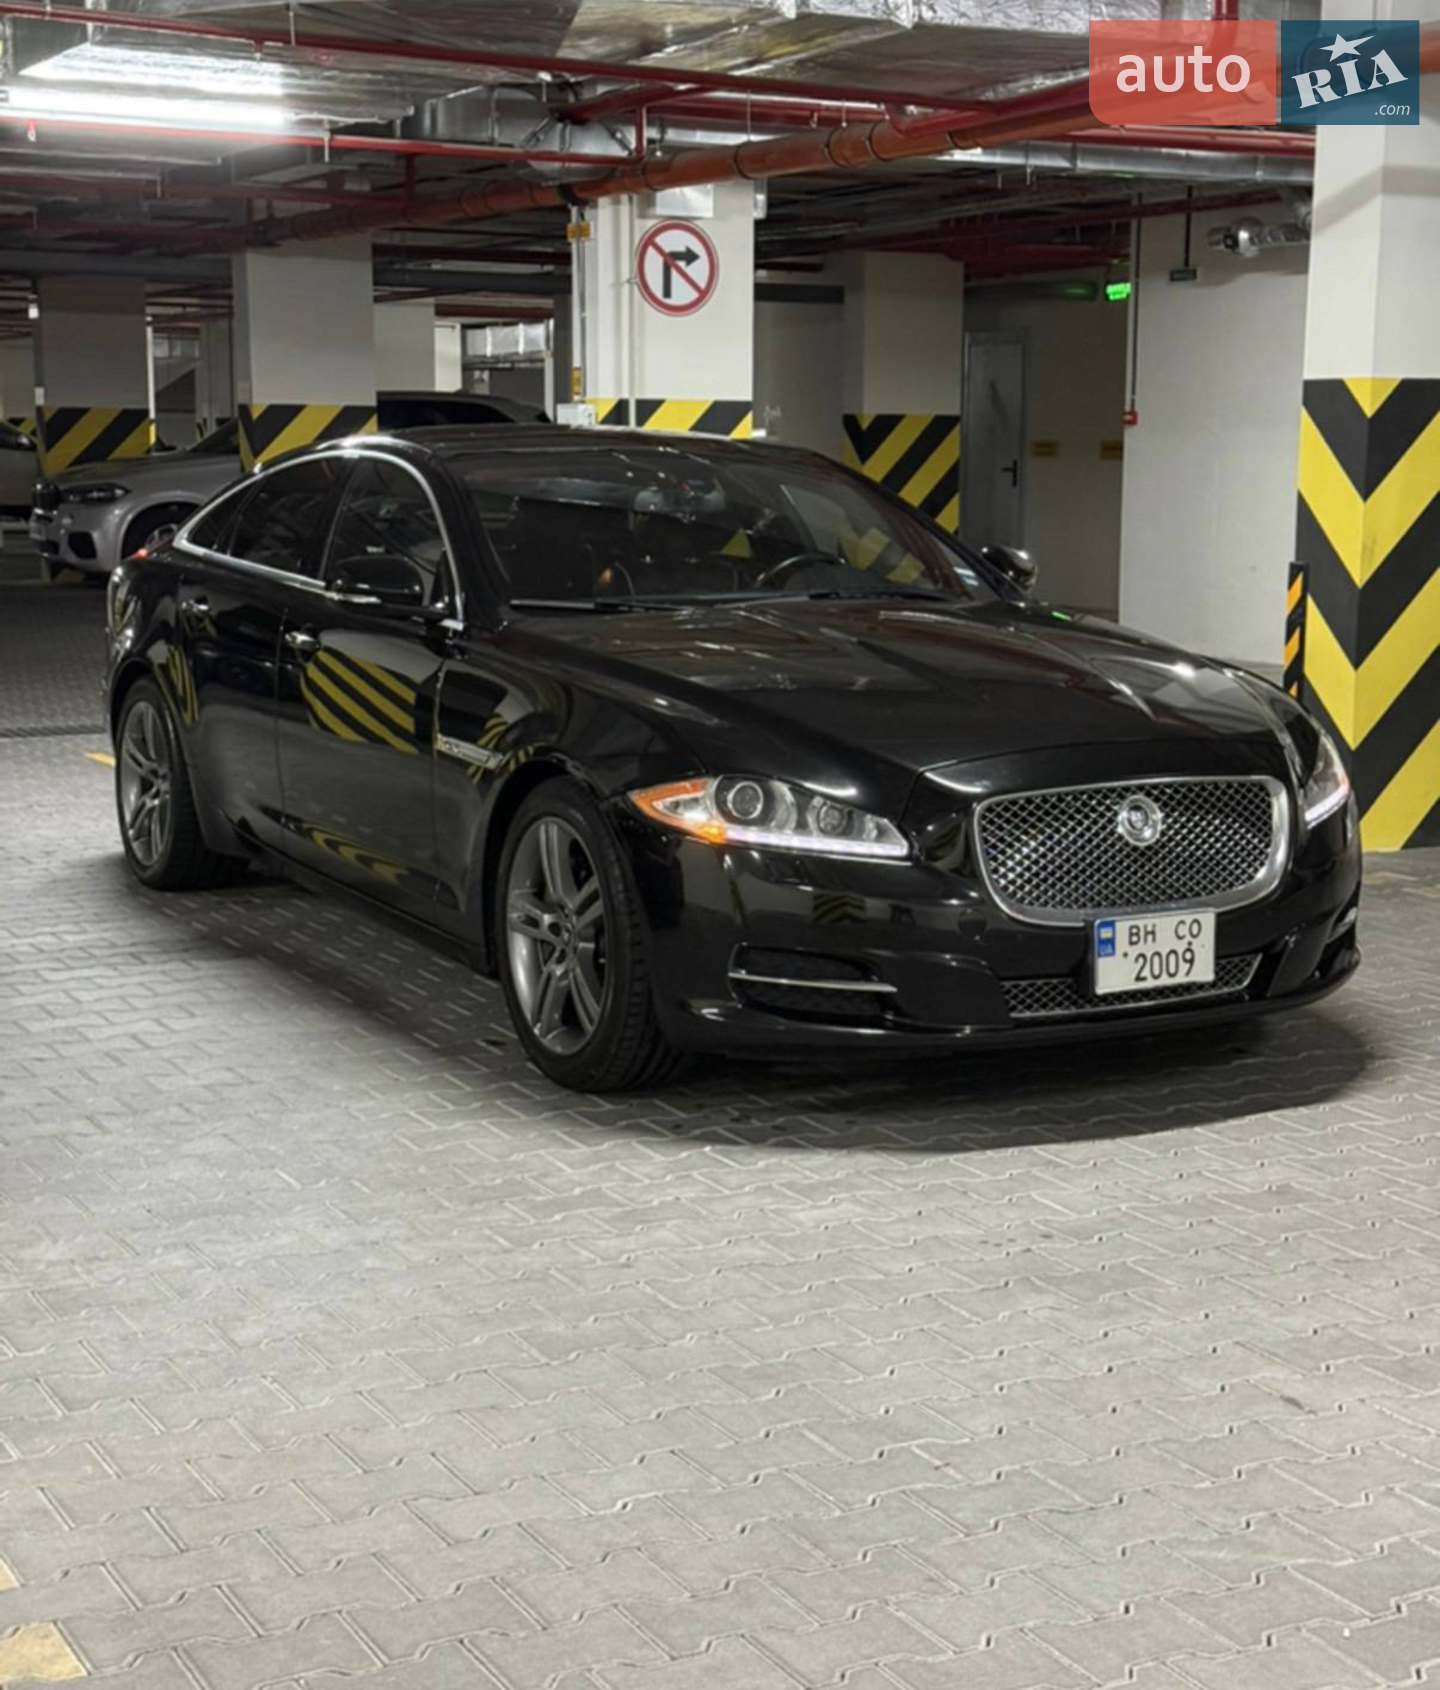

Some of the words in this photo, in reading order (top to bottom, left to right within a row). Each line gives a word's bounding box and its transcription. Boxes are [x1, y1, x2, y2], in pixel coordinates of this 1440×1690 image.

[1128, 923, 1157, 946] BH
[1174, 918, 1203, 941] CO
[1134, 947, 1196, 982] 2009
